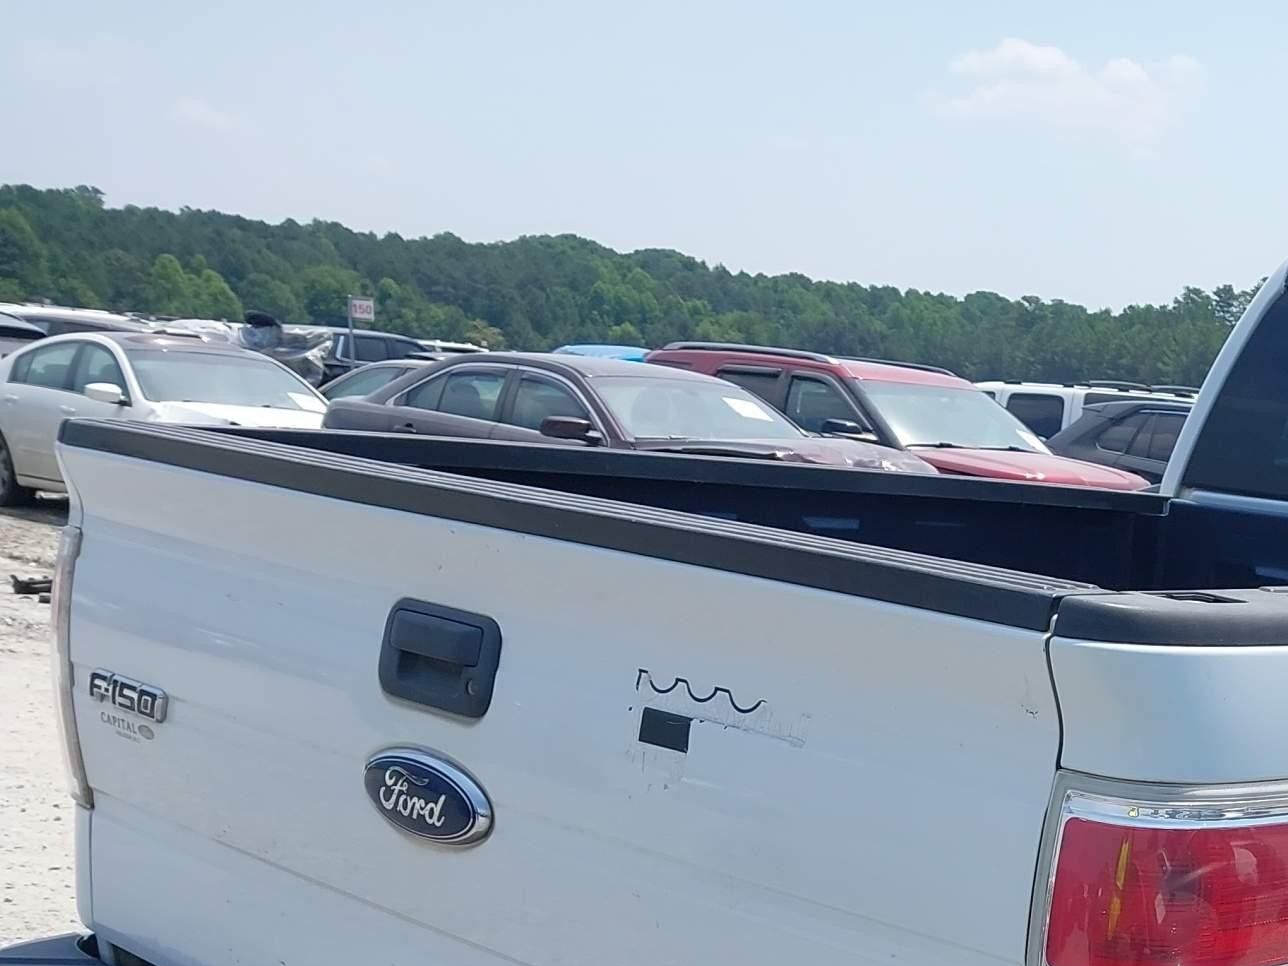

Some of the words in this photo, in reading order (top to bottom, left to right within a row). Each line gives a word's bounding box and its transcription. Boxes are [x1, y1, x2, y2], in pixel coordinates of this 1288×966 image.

[352, 303, 372, 315] 150
[89, 671, 159, 720] F-150
[100, 711, 138, 735] CAPITAL
[379, 765, 446, 827] Ford
